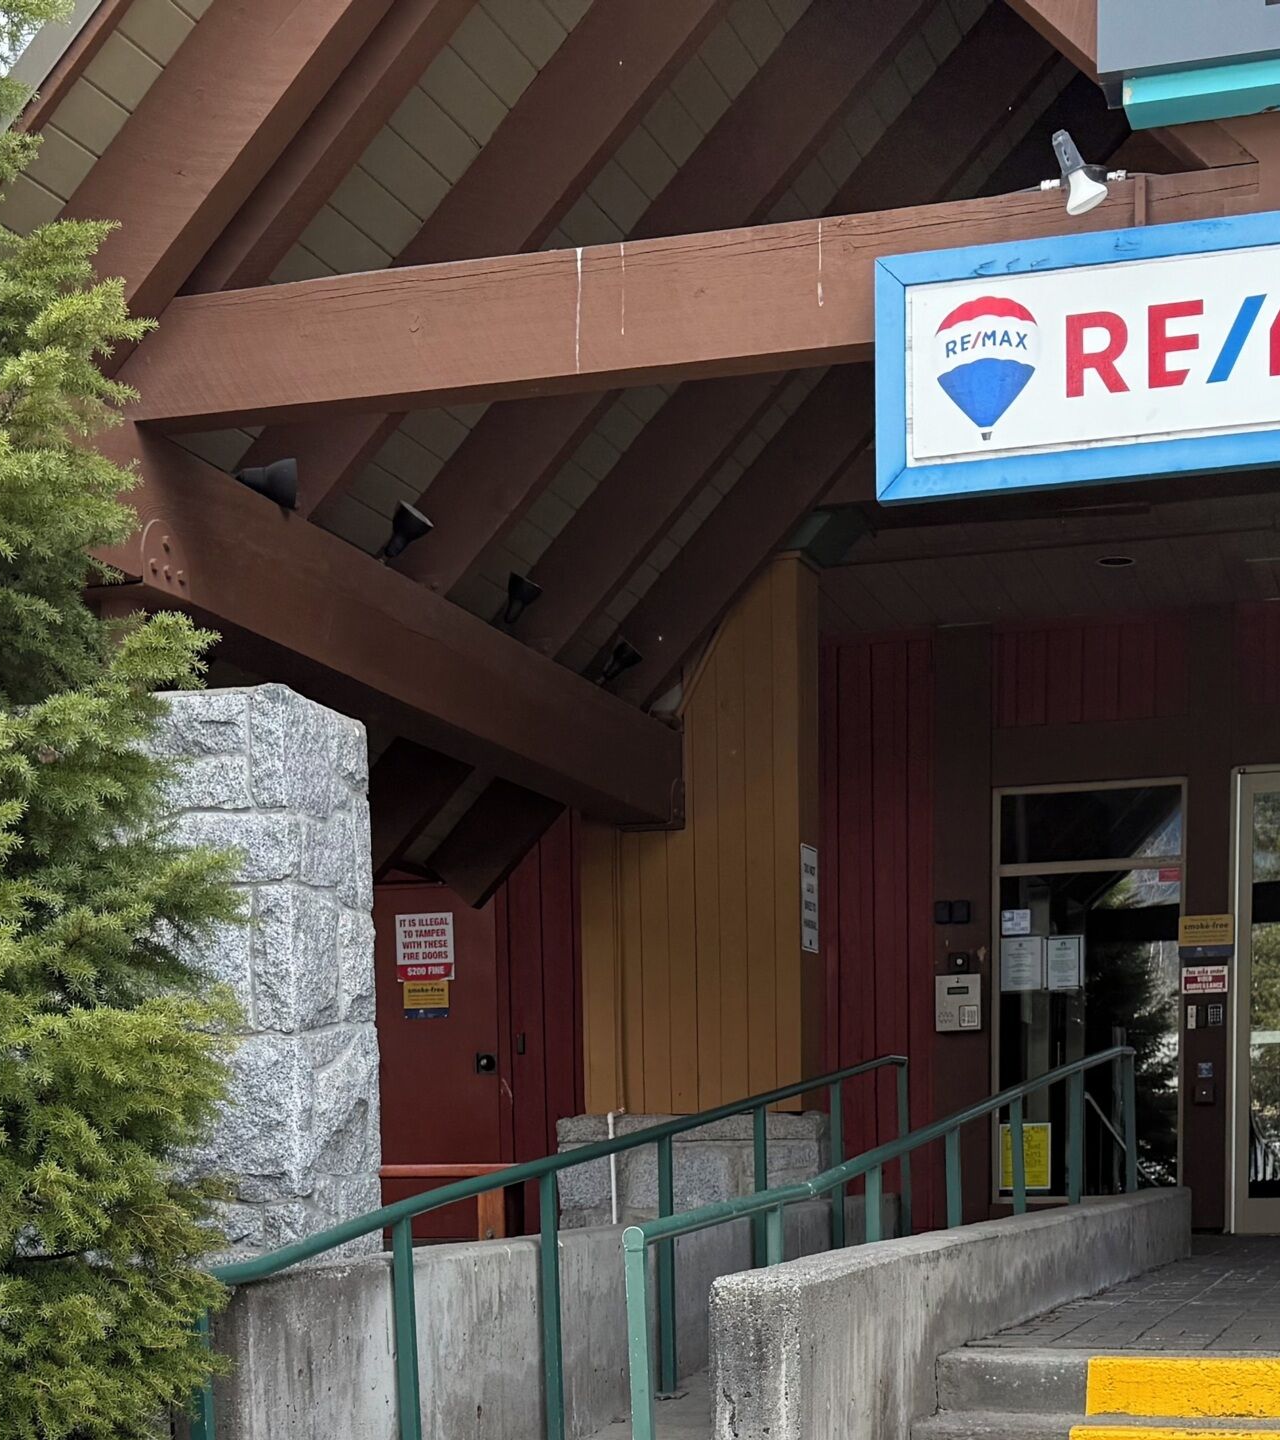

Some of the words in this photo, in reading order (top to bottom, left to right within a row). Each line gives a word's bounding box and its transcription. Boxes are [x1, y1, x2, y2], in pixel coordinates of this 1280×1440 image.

[945, 330, 1028, 358] RE/MAX
[399, 919, 406, 928] IT
[408, 919, 416, 927] IS
[418, 917, 449, 927] ILLEGAL
[1184, 922, 1229, 930] smoke-free
[403, 930, 413, 938] TO
[415, 929, 446, 938] TAMPER
[402, 941, 422, 949] WITH
[424, 940, 448, 949] THESE
[403, 952, 419, 960] FIRE
[422, 951, 448, 960] DOORS
[428, 966, 445, 975] FINE
